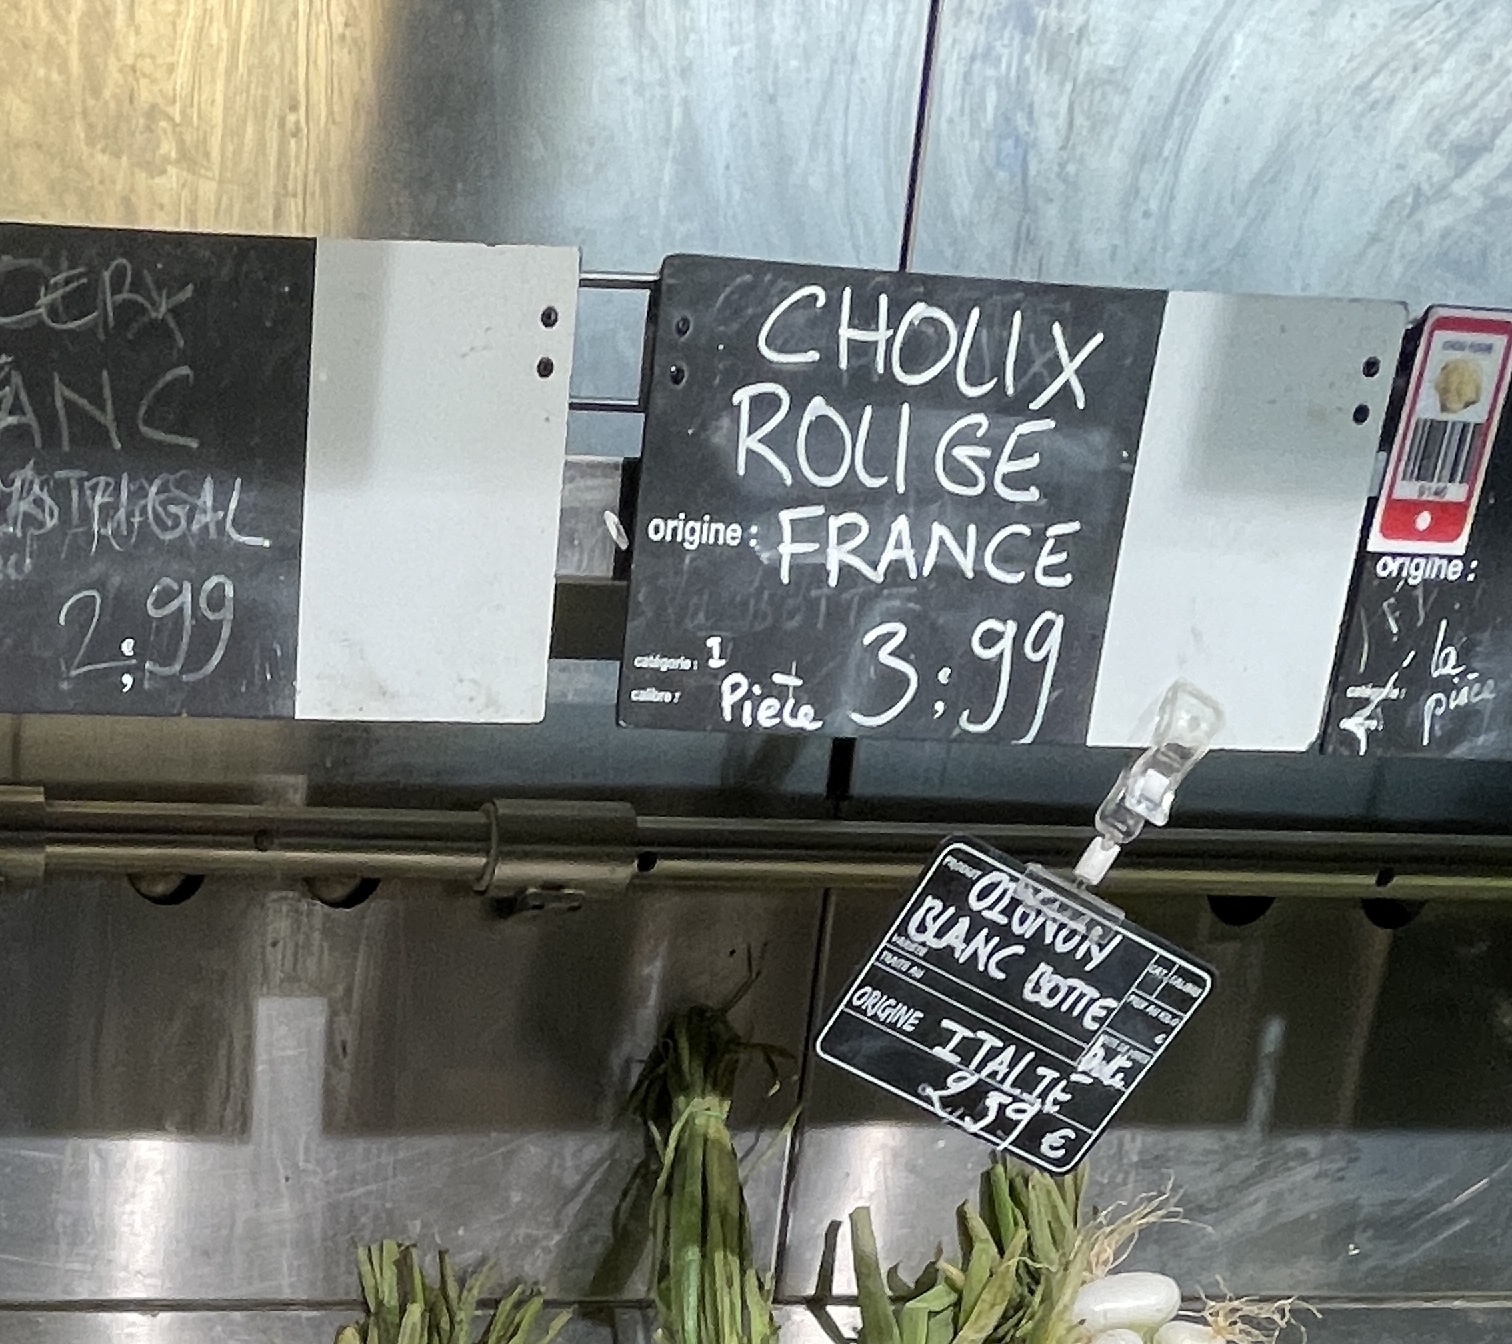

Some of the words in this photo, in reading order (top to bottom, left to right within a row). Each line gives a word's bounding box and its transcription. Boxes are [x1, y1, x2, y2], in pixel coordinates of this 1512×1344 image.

[757, 284, 1105, 412] CHOUX
[732, 382, 1056, 502] ROUGE
[777, 505, 1082, 588] FRANCE
[852, 985, 925, 1033] ORIGINE
[907, 894, 1026, 981] BLANC
[1022, 961, 1119, 1031] BOTTE
[933, 1018, 1072, 1114] ITALIE
[1040, 1128, 1076, 1159] €
